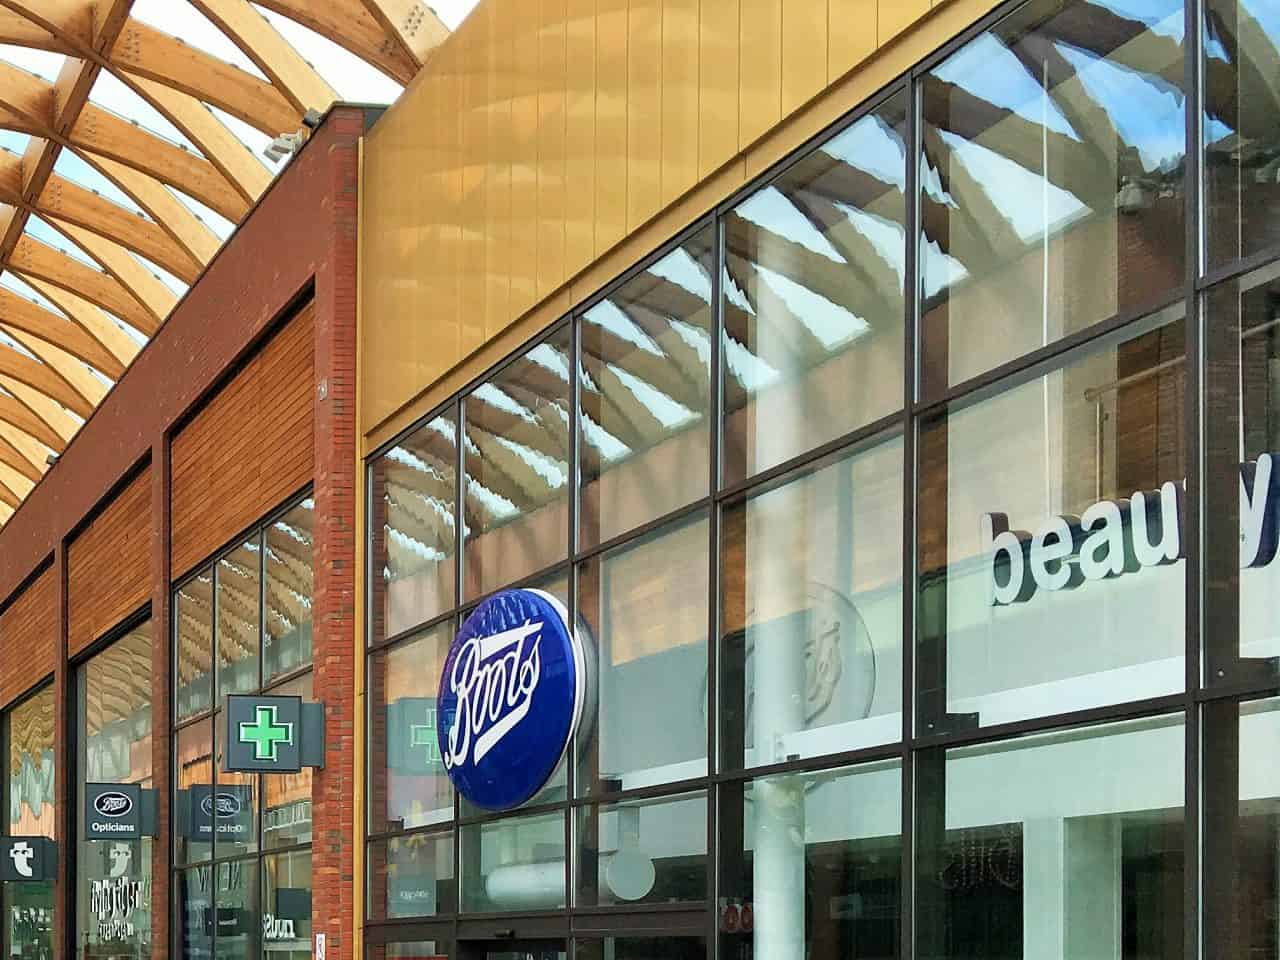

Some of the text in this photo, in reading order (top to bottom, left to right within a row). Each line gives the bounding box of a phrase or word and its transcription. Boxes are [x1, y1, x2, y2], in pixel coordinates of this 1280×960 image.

[982, 453, 1273, 606] beauy
[444, 618, 544, 770] Boots
[92, 822, 135, 833] Opticians
